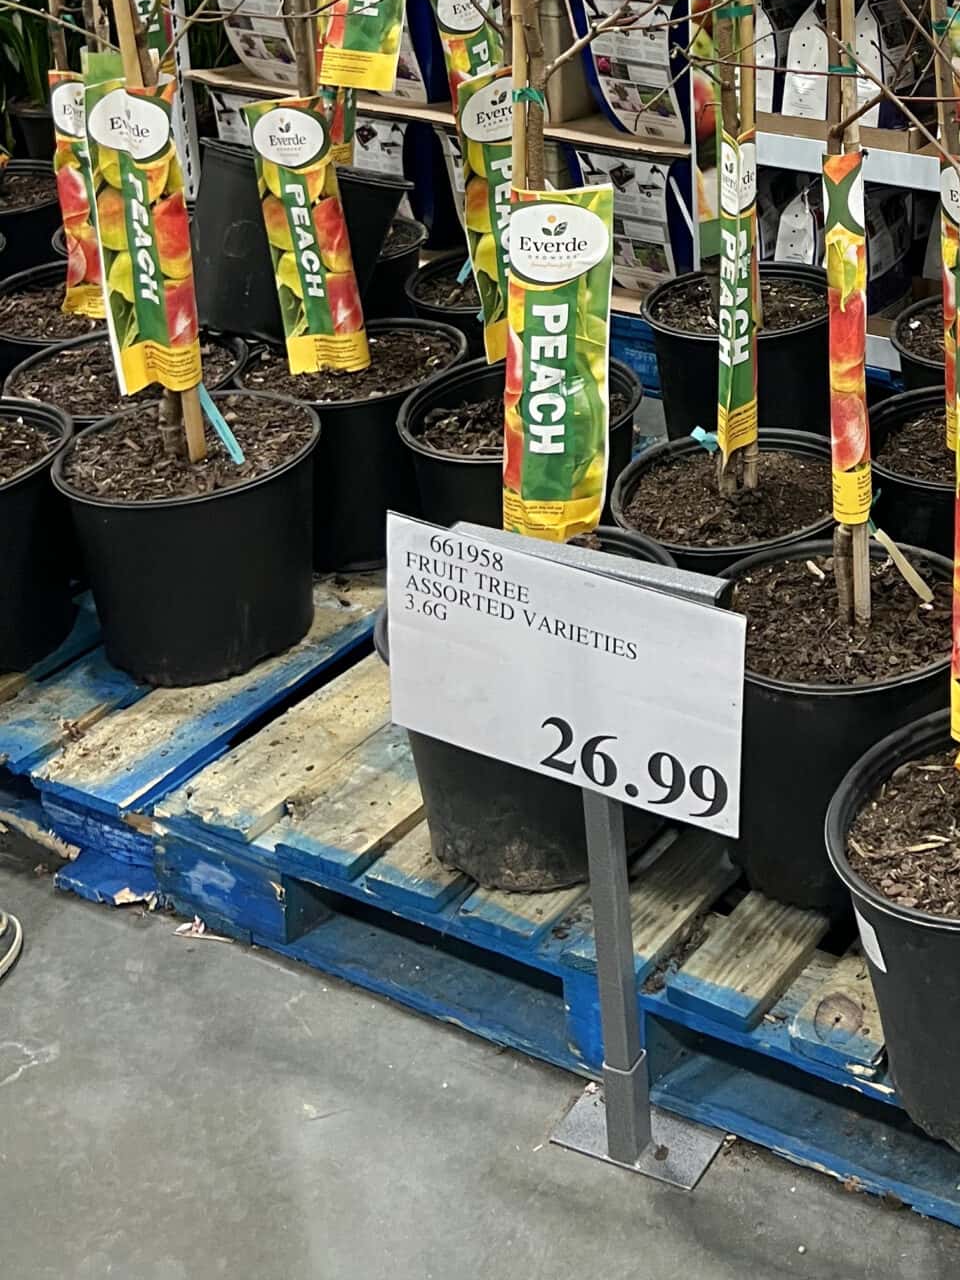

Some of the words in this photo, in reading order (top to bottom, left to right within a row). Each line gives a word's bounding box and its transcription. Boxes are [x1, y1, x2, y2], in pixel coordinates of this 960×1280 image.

[62, 103, 84, 116] Ever
[475, 103, 512, 125] Ever
[268, 133, 307, 147] Everde
[128, 172, 160, 305] PEACH
[284, 183, 325, 298] PEACH
[519, 236, 588, 253] Everde
[527, 302, 570, 455] PEACH
[429, 534, 504, 572] 661958
[406, 551, 470, 584] FRUIT
[474, 571, 530, 605] TREE
[404, 593, 448, 622] 3.6G
[405, 574, 515, 621] ASSORTED
[523, 609, 639, 661] VARIETIES
[540, 716, 729, 818] 26.99
